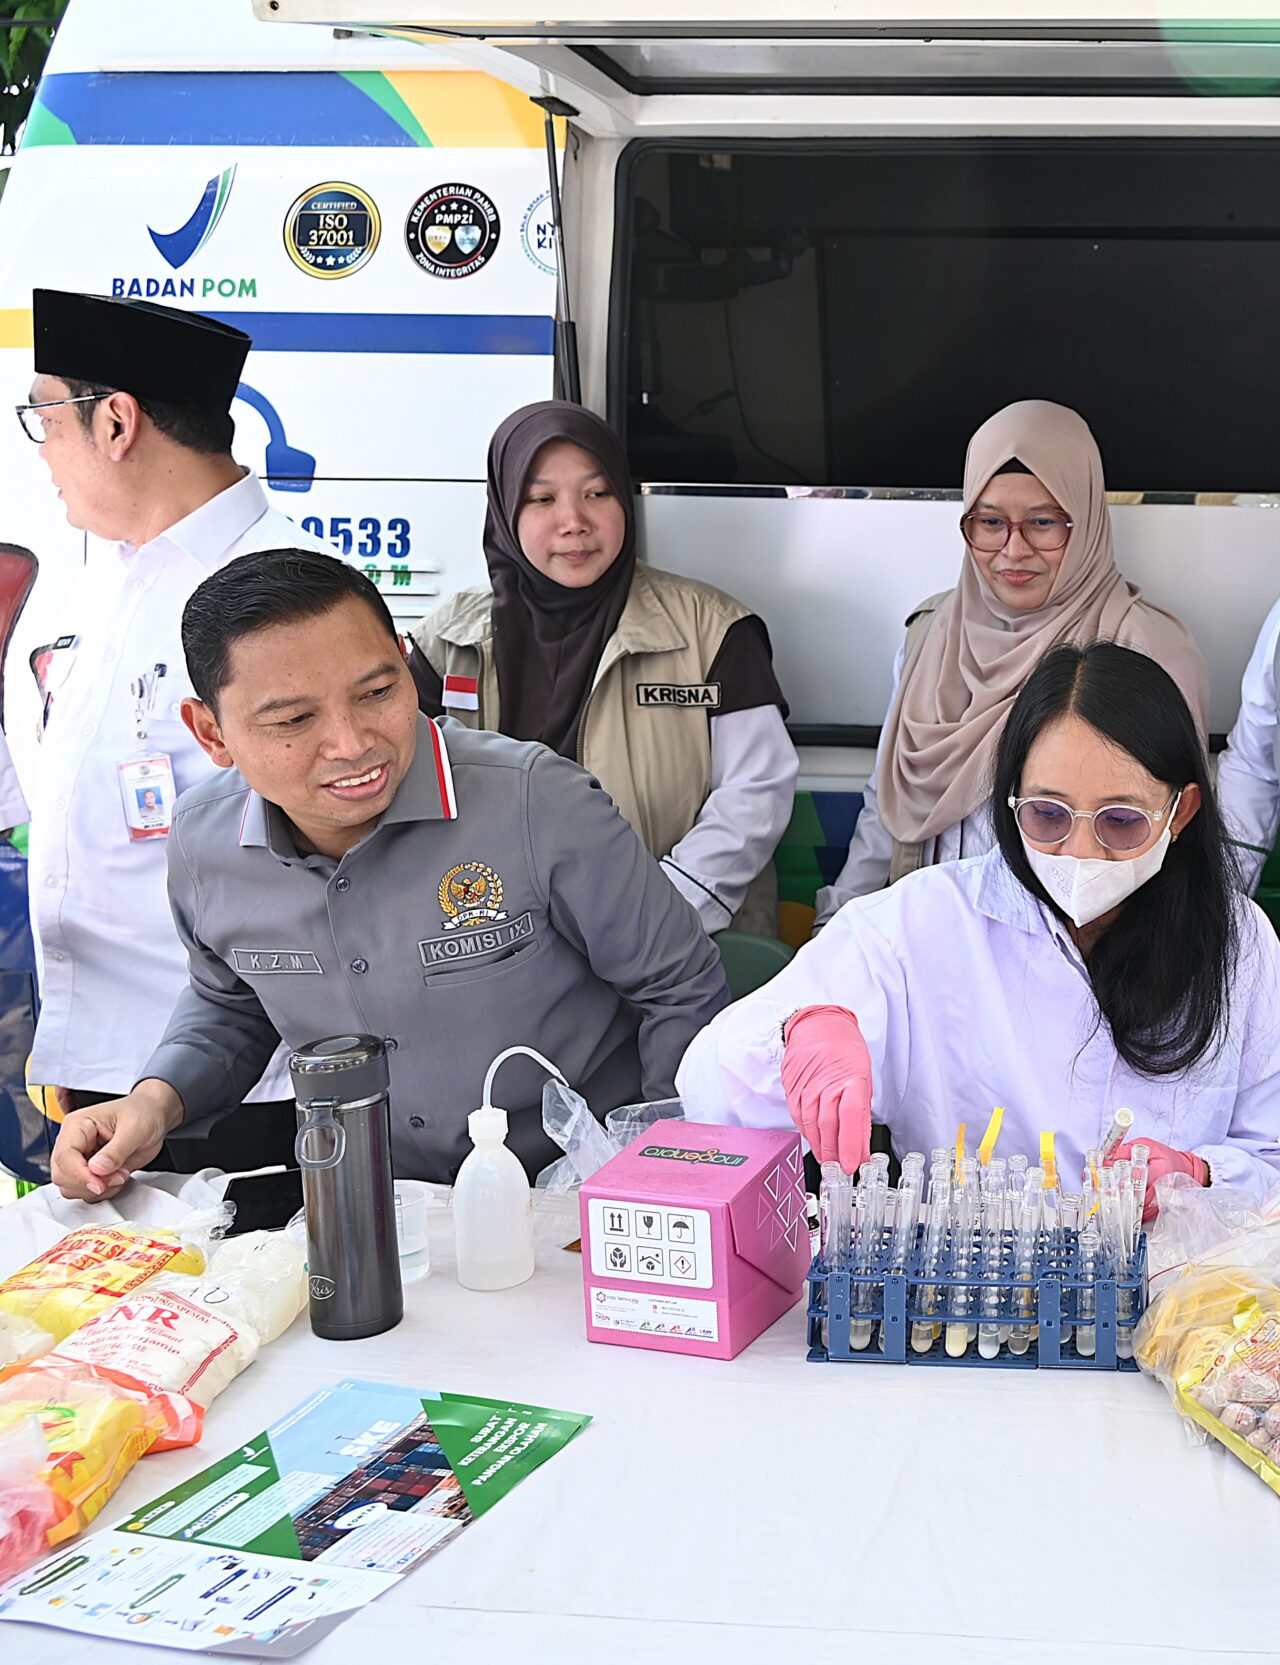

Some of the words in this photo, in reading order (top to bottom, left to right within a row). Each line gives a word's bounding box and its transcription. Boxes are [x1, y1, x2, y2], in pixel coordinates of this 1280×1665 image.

[311, 201, 357, 210] CERTIFIED
[410, 186, 473, 223] KEMENTERIAN
[473, 192, 497, 222] PANRB
[318, 215, 348, 230] ISO
[537, 221, 556, 236] NY
[309, 230, 355, 246] 37001
[415, 252, 436, 273] ZONA
[435, 255, 486, 278] INTEGRITAS
[112, 278, 195, 298] BADAN
[202, 278, 257, 298] POM
[643, 687, 714, 704] KRISNA
[430, 930, 503, 960] KOMISI
[509, 920, 526, 939] IX
[250, 953, 304, 969] K.Z.M
[310, 1276, 333, 1297] Kris
[174, 1304, 211, 1325] SPESIAL
[338, 1419, 402, 1458] SKE
[470, 1414, 502, 1443] SURAT
[493, 1421, 531, 1453] EKSPOR
[457, 1417, 518, 1466] KETERANGAN
[471, 1453, 514, 1486] PANGAN
[508, 1422, 549, 1456] OLAHAN
